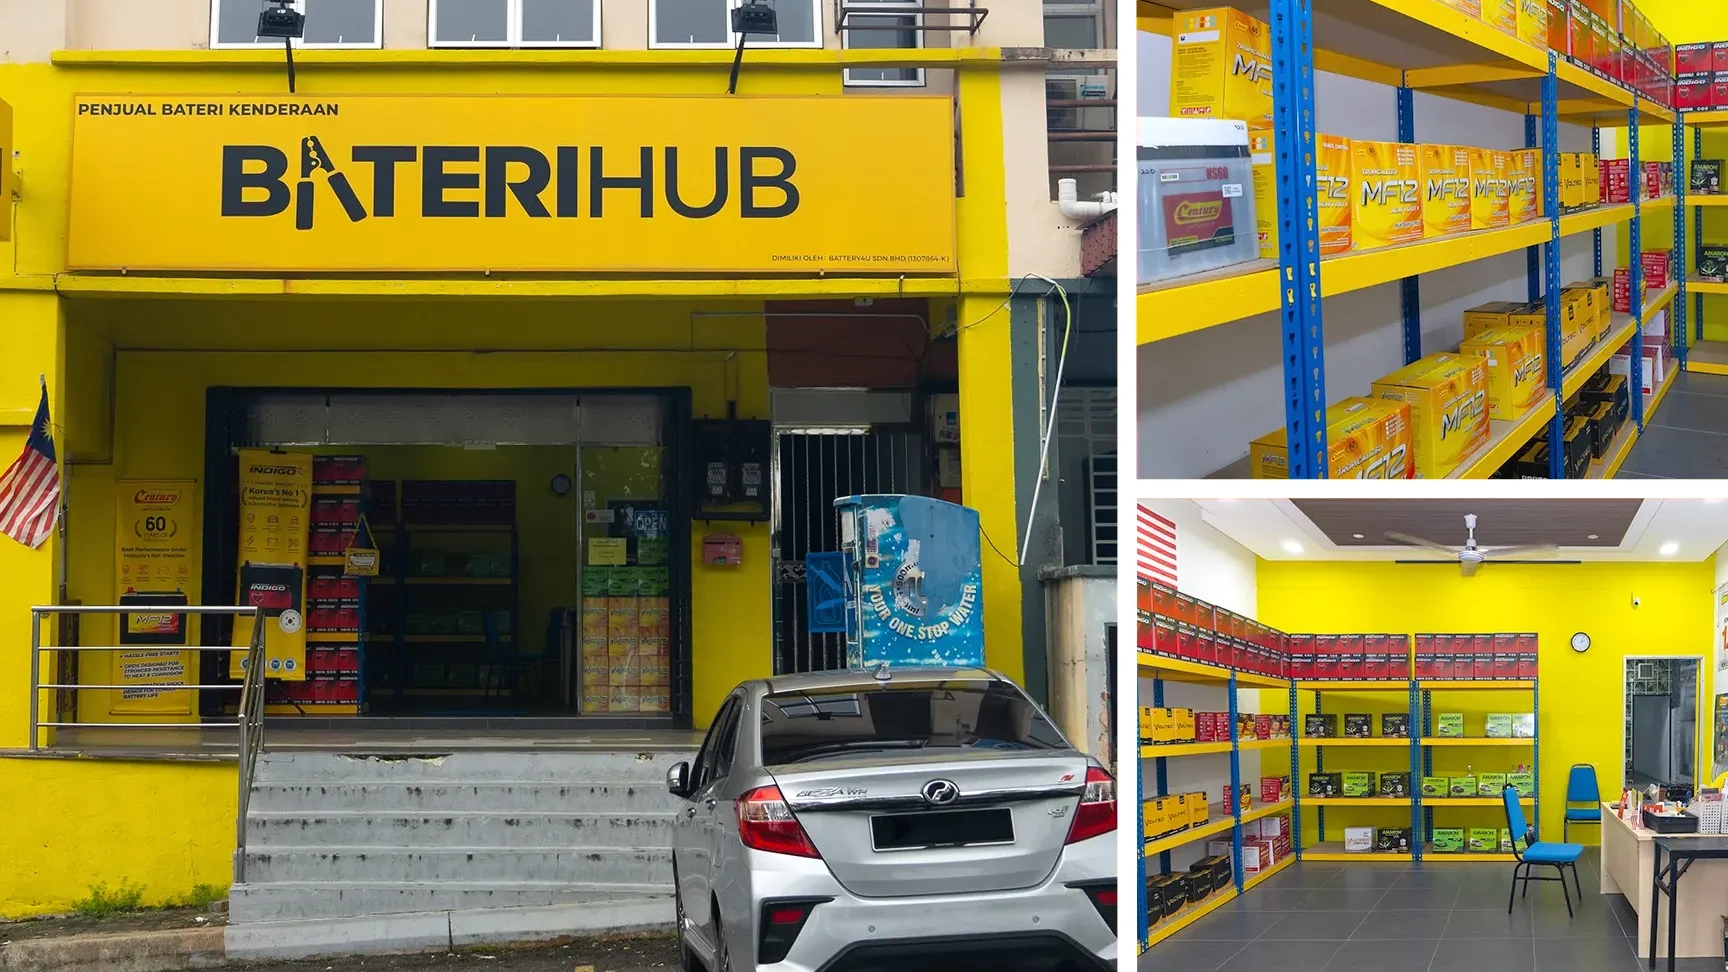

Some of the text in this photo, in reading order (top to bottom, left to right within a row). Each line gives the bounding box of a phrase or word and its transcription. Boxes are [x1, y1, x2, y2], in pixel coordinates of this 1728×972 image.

[1232, 53, 1272, 83] MF
[78, 103, 339, 116] PENJUAL BATERI KENDERAAN
[1316, 176, 1348, 198] F12
[1428, 178, 1469, 201] MF12
[1474, 178, 1507, 198] MF12
[1507, 177, 1535, 197] MF12
[1564, 178, 1582, 189] VOLTEC
[1361, 180, 1418, 206] MF12
[1176, 202, 1221, 221] Century
[1579, 316, 1594, 334] VOLTEC
[1562, 330, 1576, 346] OLTEC
[1514, 353, 1542, 388] MF12
[1441, 390, 1484, 441] MF12
[250, 467, 296, 476] INDIGO
[134, 489, 178, 504] Century
[145, 516, 166, 532] 60
[636, 515, 667, 531] OPEN
[136, 615, 172, 624] MF12
[868, 585, 892, 621] YOUR
[889, 620, 914, 639] ONE
[917, 621, 950, 640] STOP
[950, 584, 977, 627] WATER
[1167, 893, 1185, 906] VOLTEC
